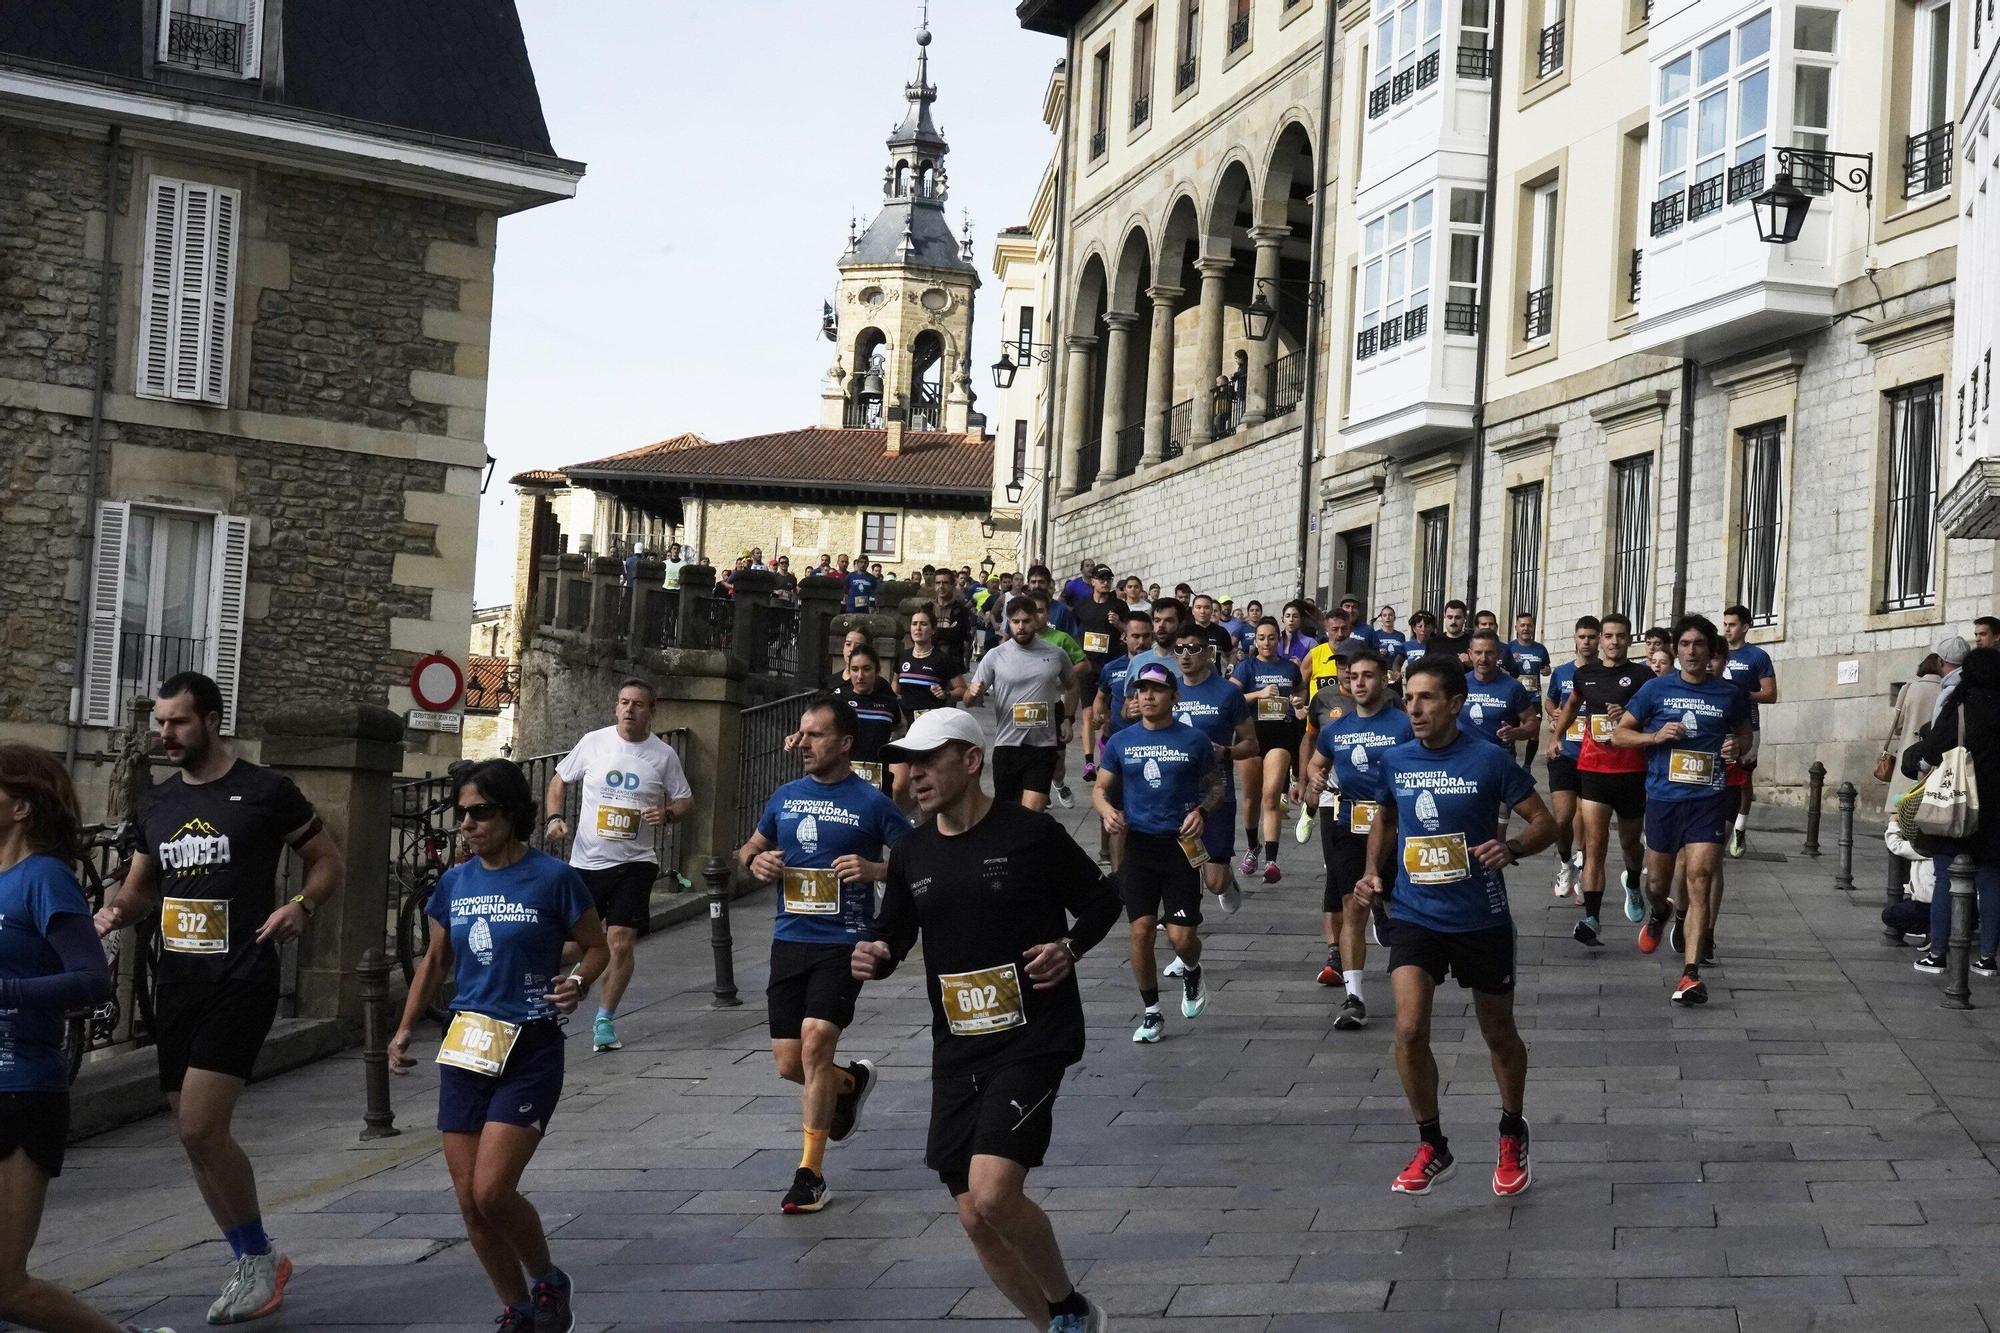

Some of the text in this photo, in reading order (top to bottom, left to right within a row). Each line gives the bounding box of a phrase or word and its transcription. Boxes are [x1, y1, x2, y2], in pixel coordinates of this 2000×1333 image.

[1268, 702, 1282, 711] 507
[1672, 702, 1716, 711] ALMENDRA
[1024, 710, 1038, 718] 477
[1342, 735, 1386, 744] ALMENDRA
[1133, 750, 1180, 758] ALMENDRA
[1682, 758, 1704, 772] 208
[606, 770, 640, 790] OD
[1402, 770, 1448, 780] CONQUISTA
[1404, 777, 1465, 788] ALMENDRA
[1434, 786, 1478, 794] KONKISTA
[790, 805, 848, 818] ALMENDRA
[607, 814, 630, 828] 500
[818, 814, 859, 826] KONKISTA
[1418, 847, 1450, 866] 245
[177, 868, 210, 878] TRAIL
[801, 880, 816, 896] 41
[458, 894, 506, 906] CONQUISTA
[458, 902, 524, 916] ALMENDRA
[178, 912, 207, 932] 372
[490, 914, 538, 923] KONKISTA
[958, 985, 999, 1012] 602
[462, 1026, 494, 1052] 105
